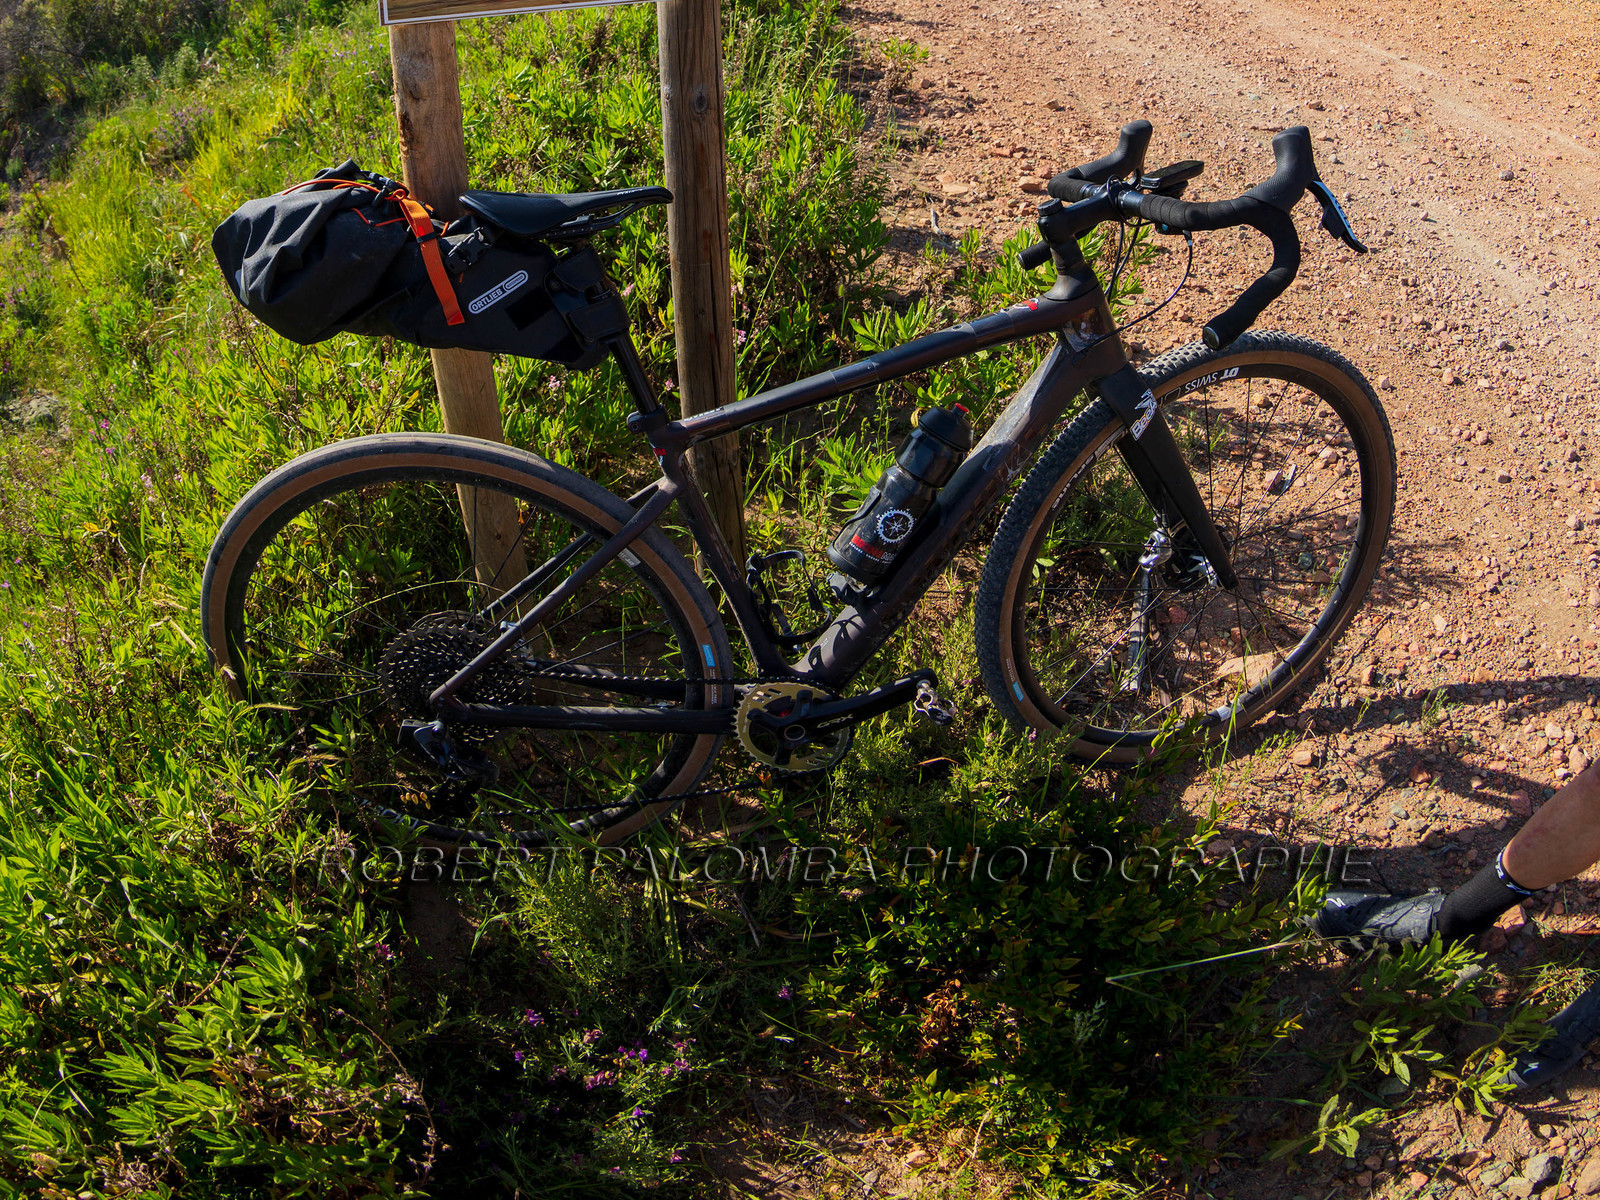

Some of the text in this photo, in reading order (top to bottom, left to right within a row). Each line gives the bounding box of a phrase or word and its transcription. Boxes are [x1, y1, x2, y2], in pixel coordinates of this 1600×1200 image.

[471, 288, 503, 311] ORTLIEB
[1184, 366, 1240, 394] DT SWISS
